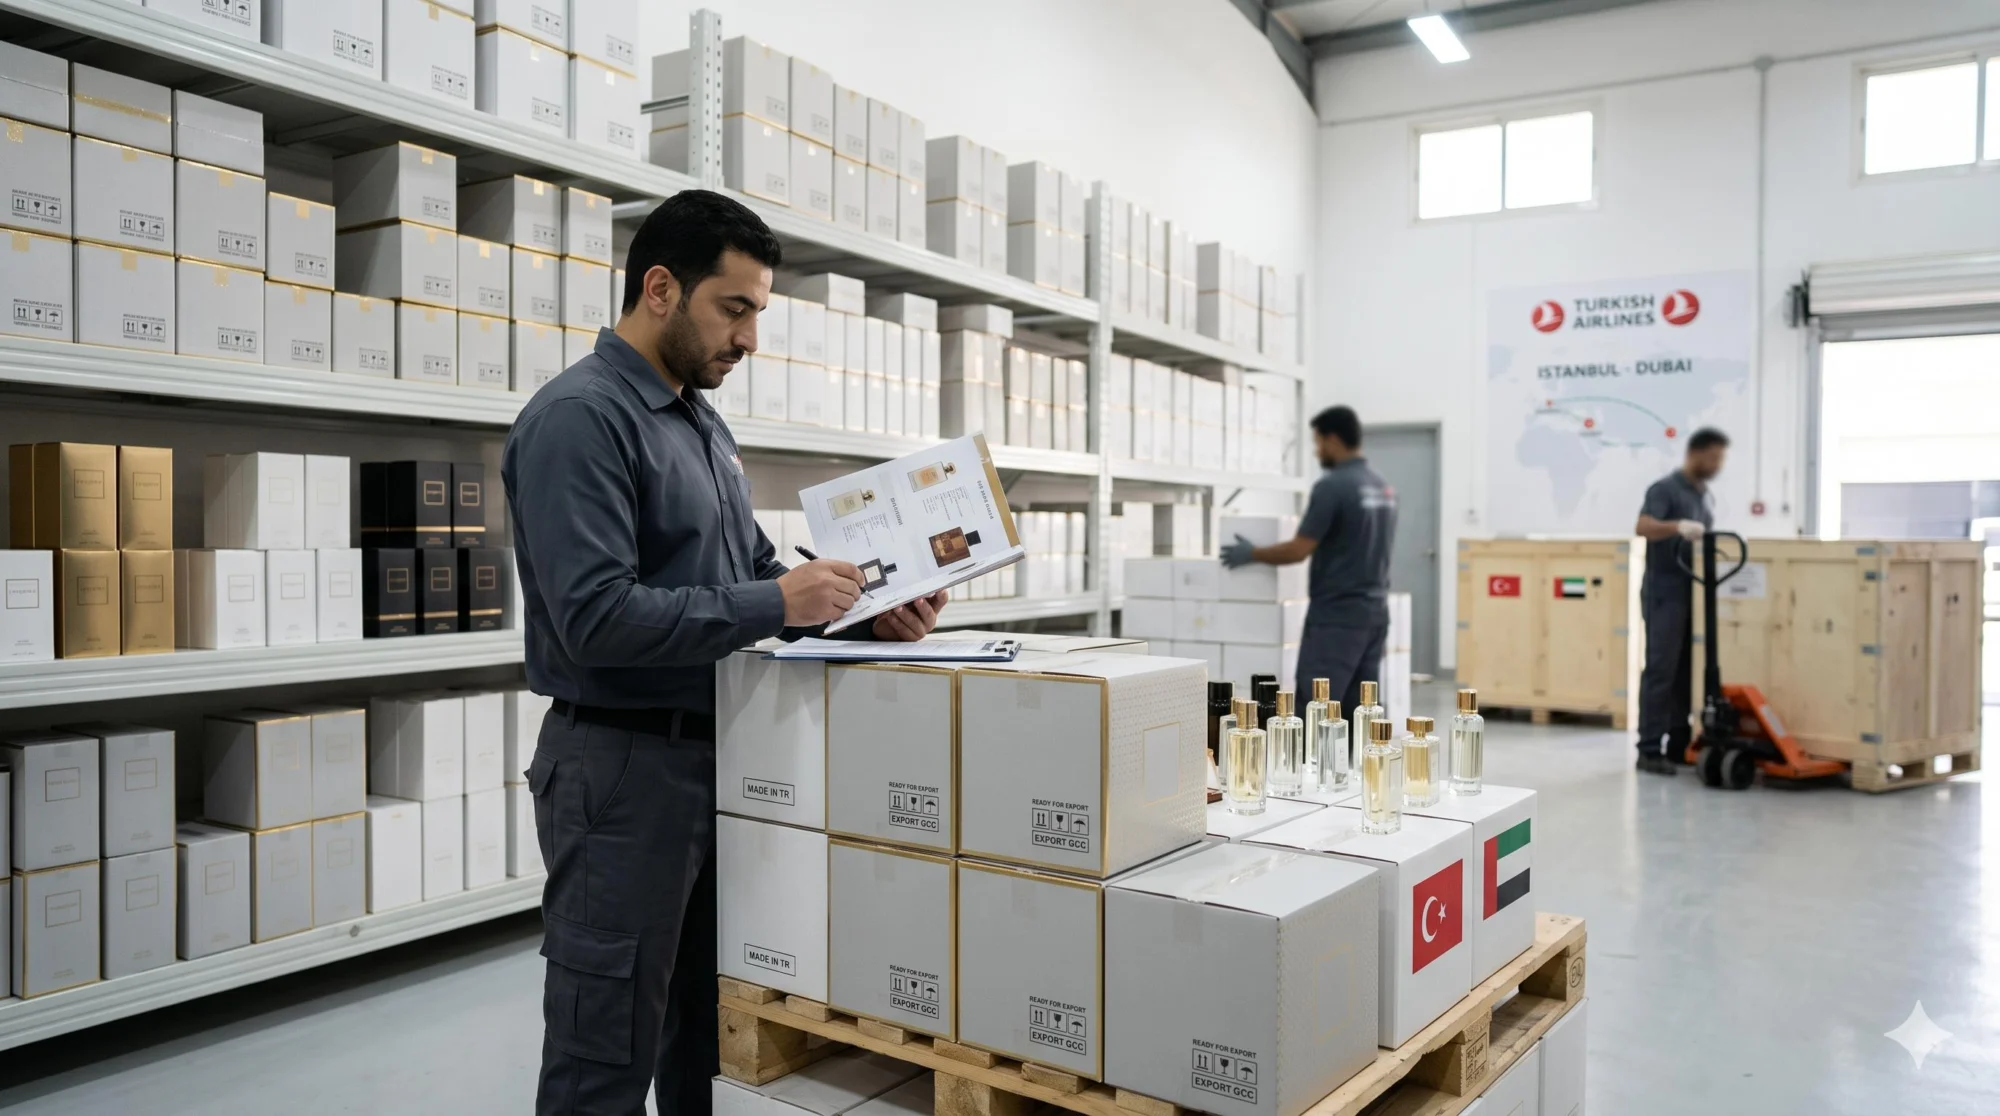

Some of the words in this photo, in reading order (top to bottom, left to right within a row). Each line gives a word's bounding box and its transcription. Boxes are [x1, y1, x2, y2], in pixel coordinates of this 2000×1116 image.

[1573, 295, 1655, 312] TURKISH
[1573, 312, 1655, 329] AIRLINES
[1538, 363, 1620, 379] ISTANBUL
[1635, 359, 1692, 375] DUBAI
[747, 784, 768, 796] MADE
[770, 788, 778, 797] IN
[779, 789, 789, 799] TR
[888, 781, 905, 789] READY
[906, 783, 918, 791] FOR
[918, 785, 939, 794] EXPORT
[1031, 798, 1051, 806] READY
[1052, 801, 1065, 809] FOR
[1065, 802, 1089, 811] EXPORT
[891, 815, 919, 826] EXPORT
[920, 820, 937, 829] GCC
[1034, 834, 1067, 846] EXPORT
[1068, 839, 1086, 850] GCC
[749, 951, 770, 964] MADE
[771, 957, 779, 966] IN
[780, 959, 790, 969] TR
[889, 964, 906, 973] READY
[906, 968, 918, 976] FOR
[892, 997, 920, 1010] EXPORT
[921, 1005, 937, 1015] GCC
[1029, 995, 1048, 1005] READY
[1049, 1000, 1061, 1008] FOR
[1062, 1003, 1086, 1013] EXPORT
[1032, 1031, 1064, 1046] EXPORT
[1065, 1040, 1084, 1051] GCC
[1192, 1038, 1214, 1049] READY
[1215, 1044, 1229, 1053] FOR
[1229, 1047, 1257, 1059] EXPORT
[1195, 1076, 1232, 1093] EXPORT
[1233, 1087, 1254, 1099] GCC
